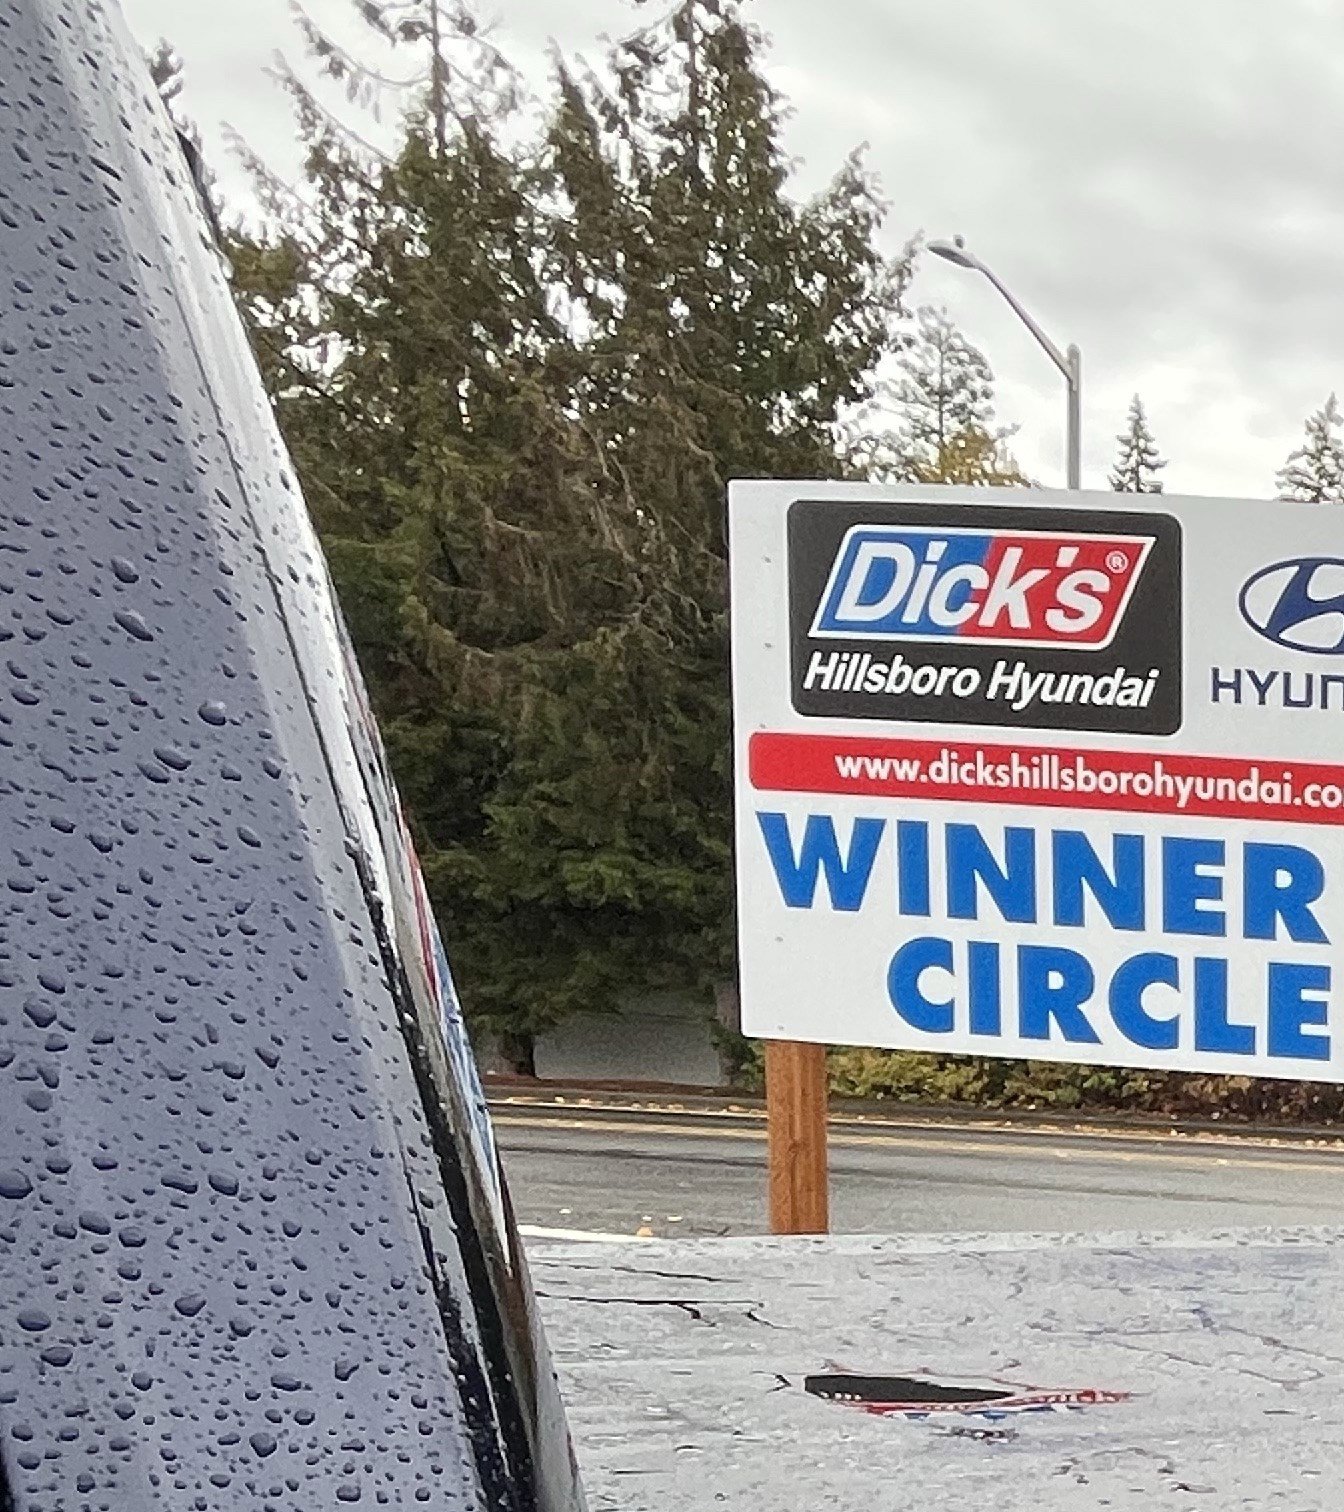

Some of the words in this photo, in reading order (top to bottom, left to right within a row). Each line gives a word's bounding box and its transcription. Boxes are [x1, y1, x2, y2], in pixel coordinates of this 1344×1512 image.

[804, 653, 982, 698] Hillsboro
[986, 660, 1160, 710] Hyundai
[886, 936, 1331, 1062] CIRCLE
